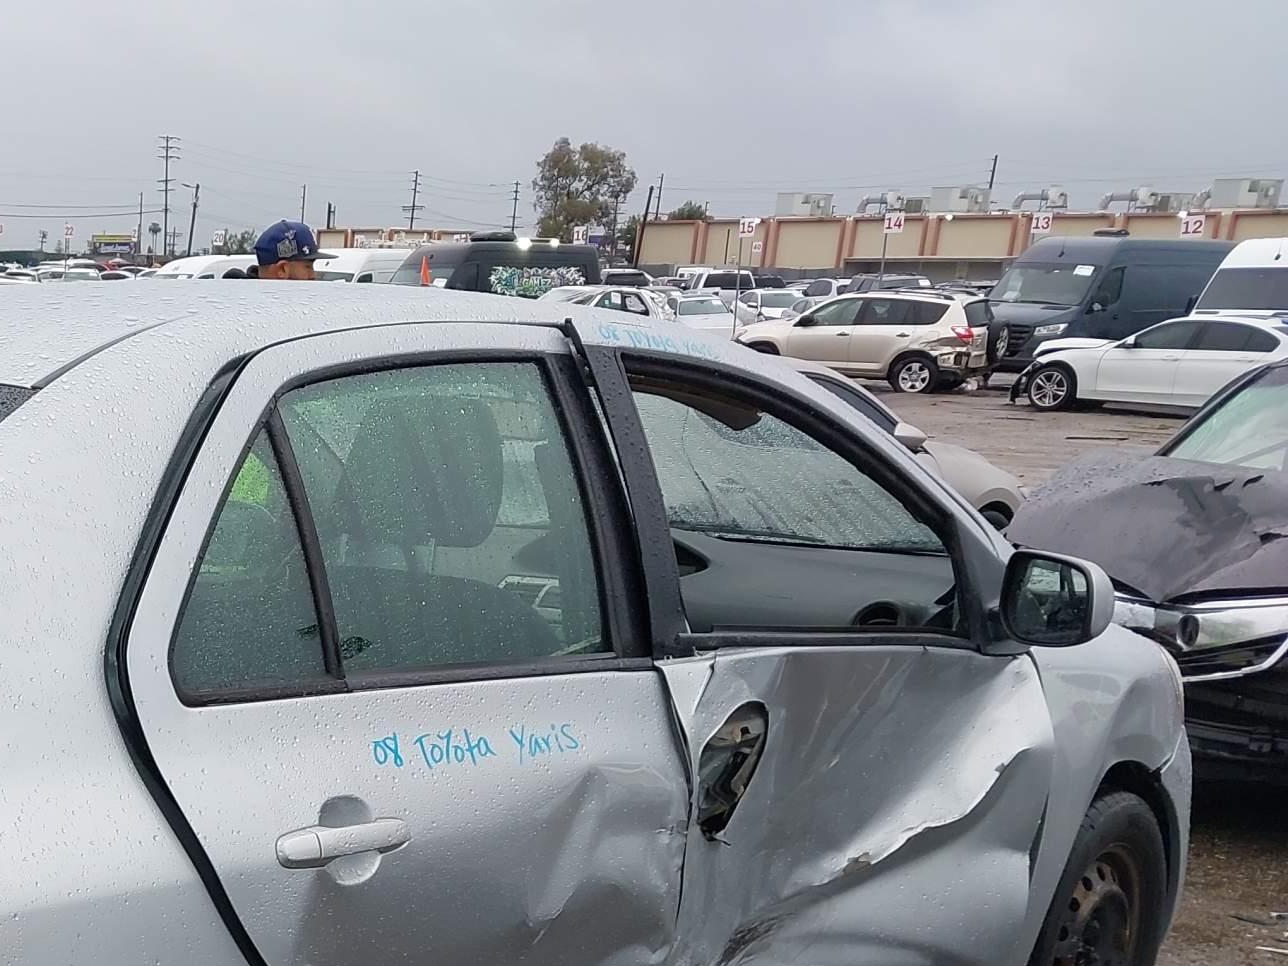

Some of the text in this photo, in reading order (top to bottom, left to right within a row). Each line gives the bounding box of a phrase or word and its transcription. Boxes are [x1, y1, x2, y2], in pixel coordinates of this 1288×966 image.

[740, 221, 754, 234] 15
[885, 216, 903, 230] 14
[1032, 216, 1051, 230] 13
[1182, 219, 1204, 234] 12
[65, 226, 74, 236] 22
[214, 232, 224, 243] 20
[372, 731, 404, 769] 08
